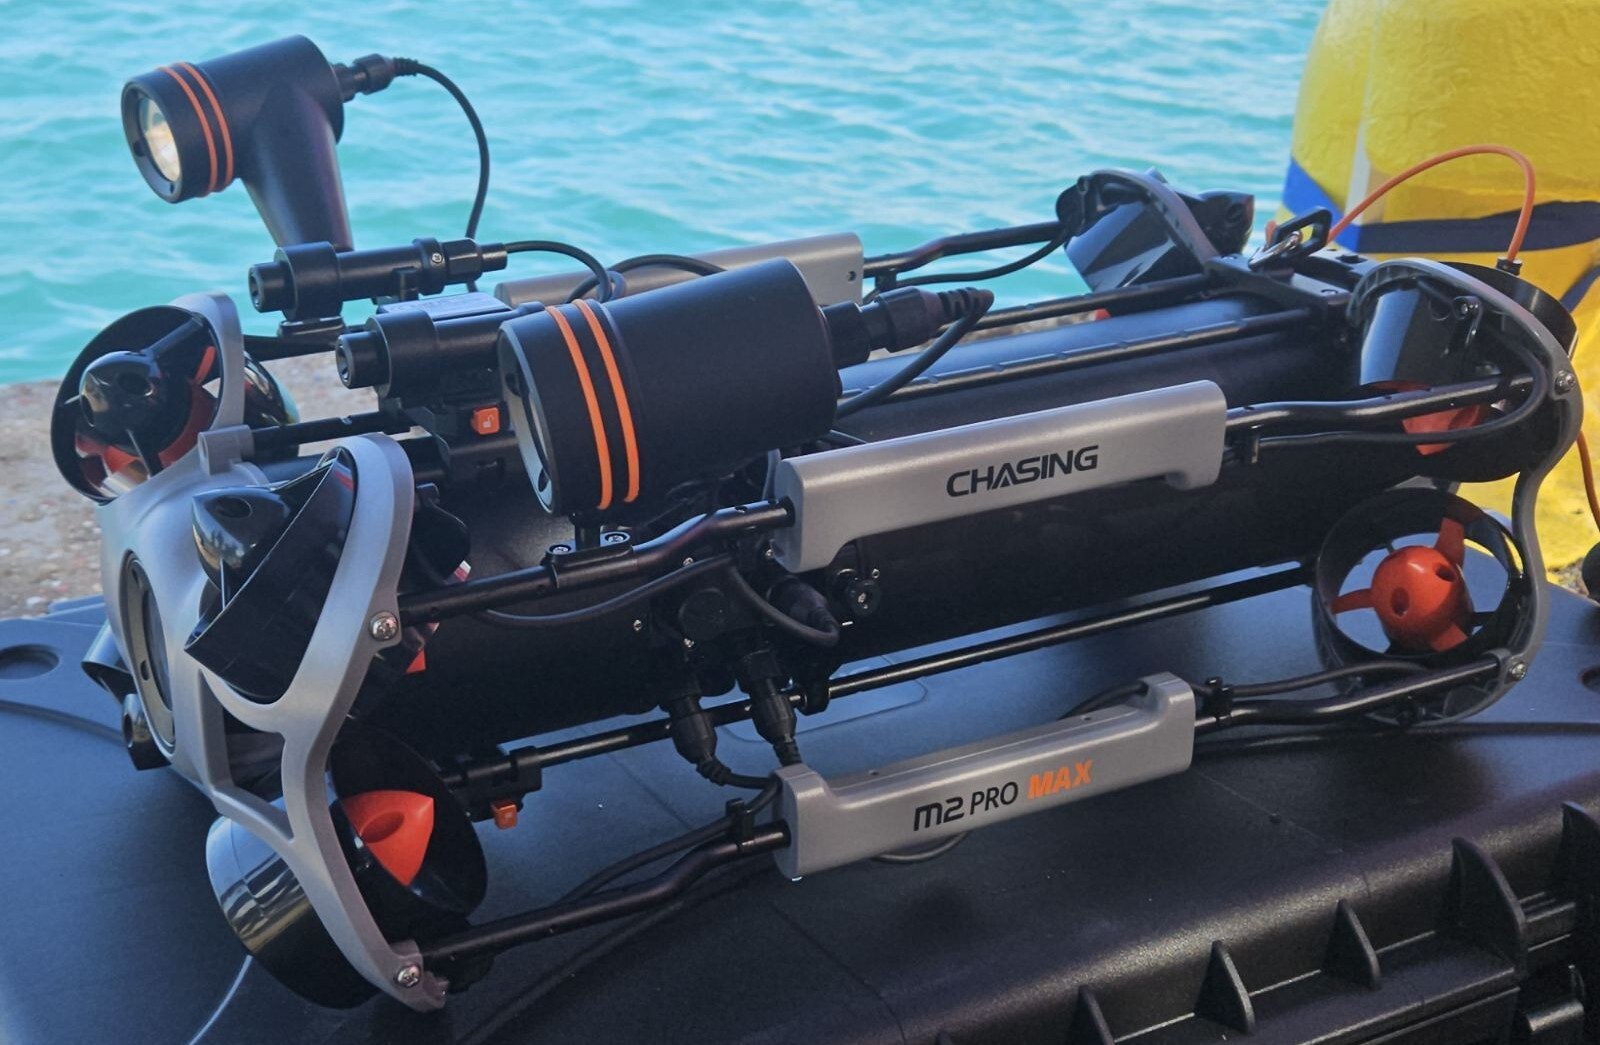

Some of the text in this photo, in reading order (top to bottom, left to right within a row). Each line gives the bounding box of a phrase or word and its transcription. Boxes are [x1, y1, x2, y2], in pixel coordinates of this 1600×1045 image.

[946, 445, 1099, 497] CHASING
[969, 782, 1019, 815] PRO
[1028, 758, 1094, 800] MAX
